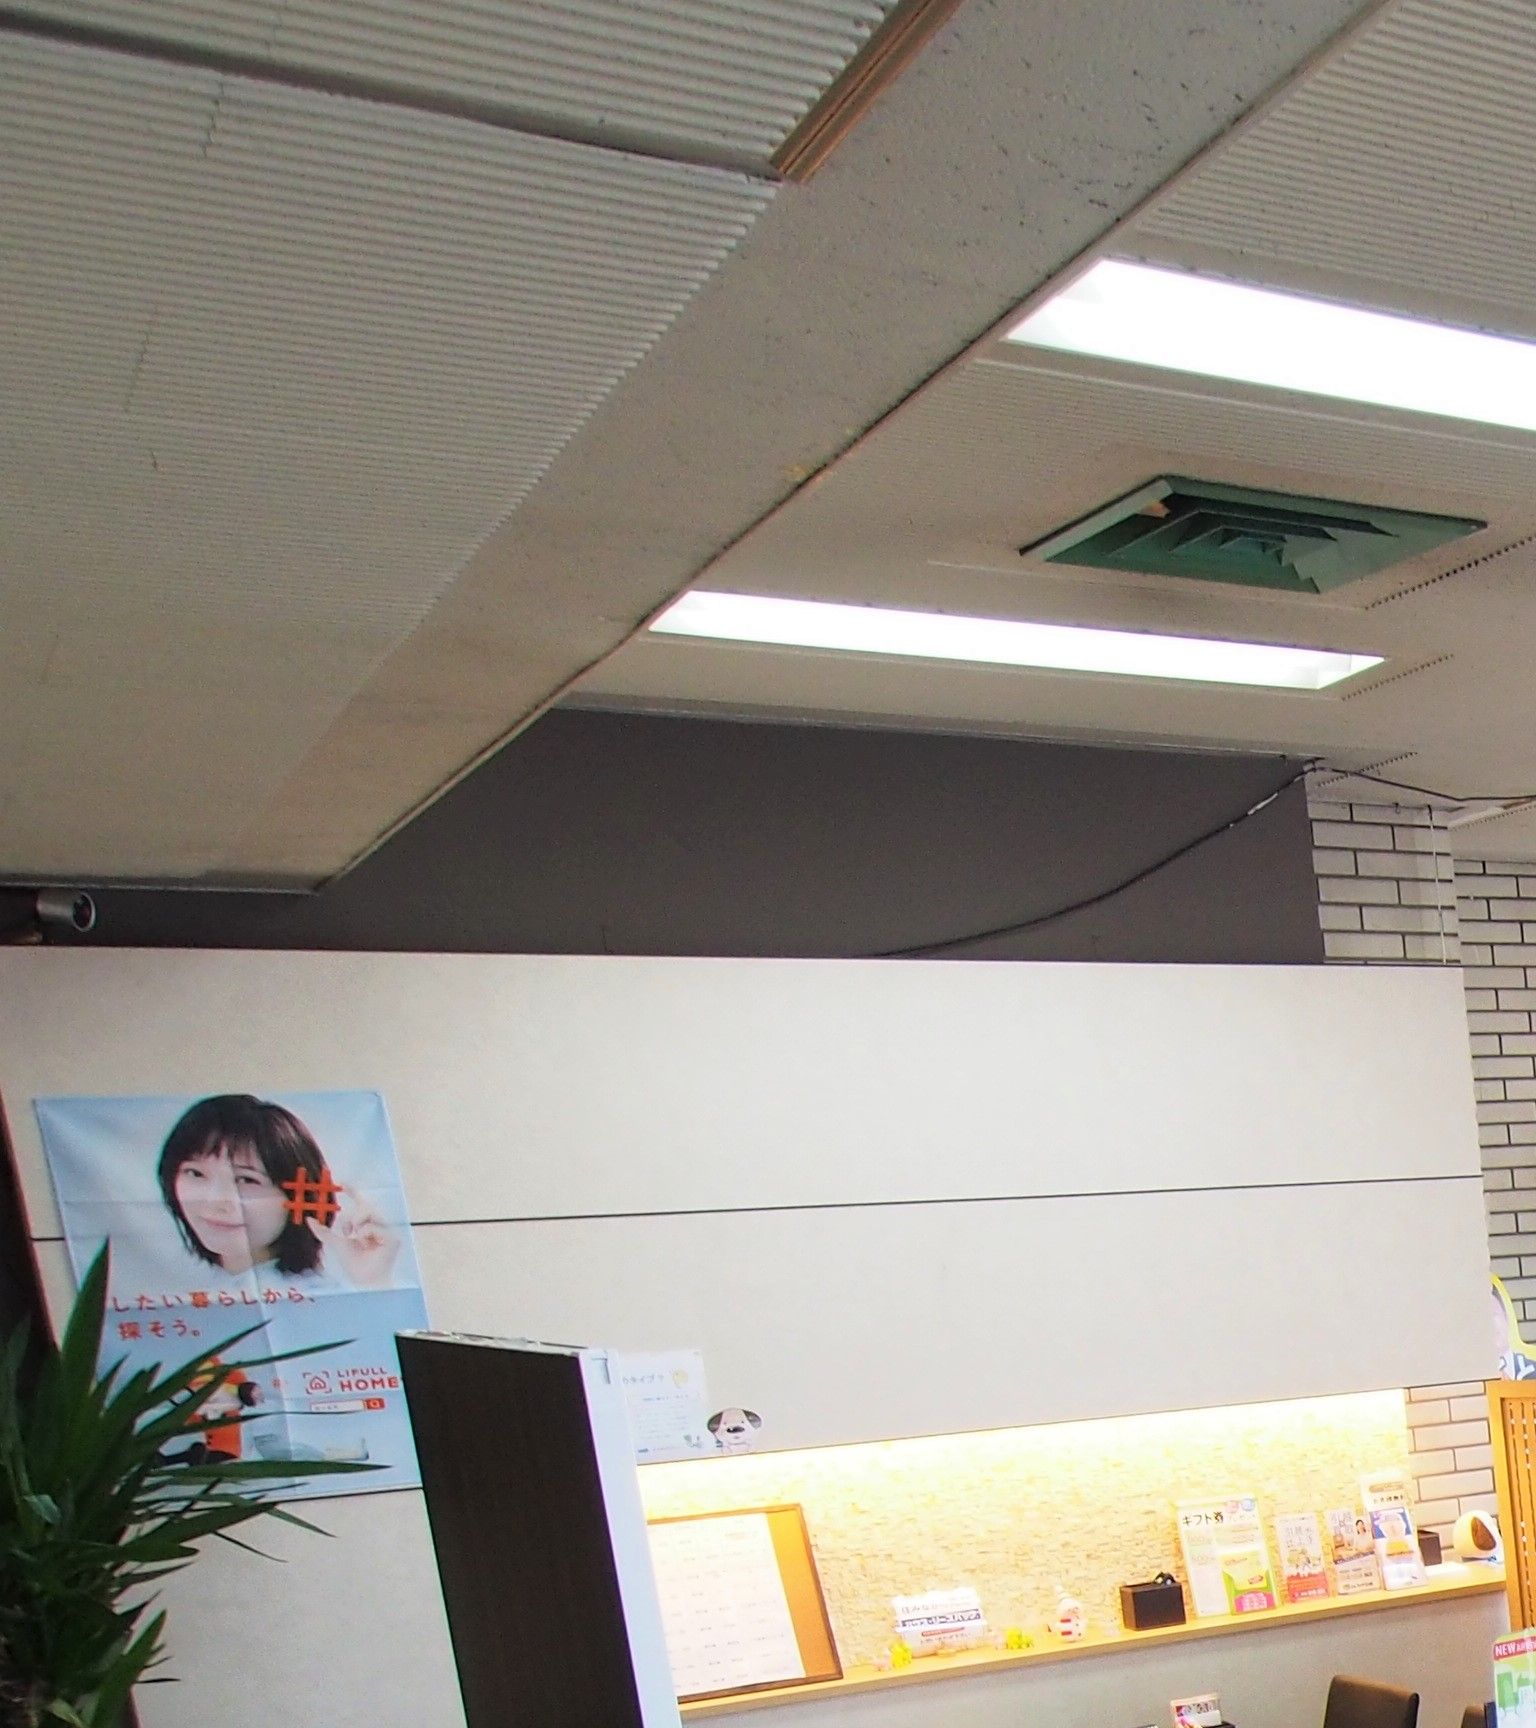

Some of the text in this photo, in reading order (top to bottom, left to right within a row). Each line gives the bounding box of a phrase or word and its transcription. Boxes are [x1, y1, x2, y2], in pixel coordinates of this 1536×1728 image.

[112, 1286, 315, 1313] したい暮らしから、
[118, 1317, 201, 1340] 探そう。
[336, 1367, 388, 1379] LIFULL
[1494, 1642, 1517, 1657] NEW
